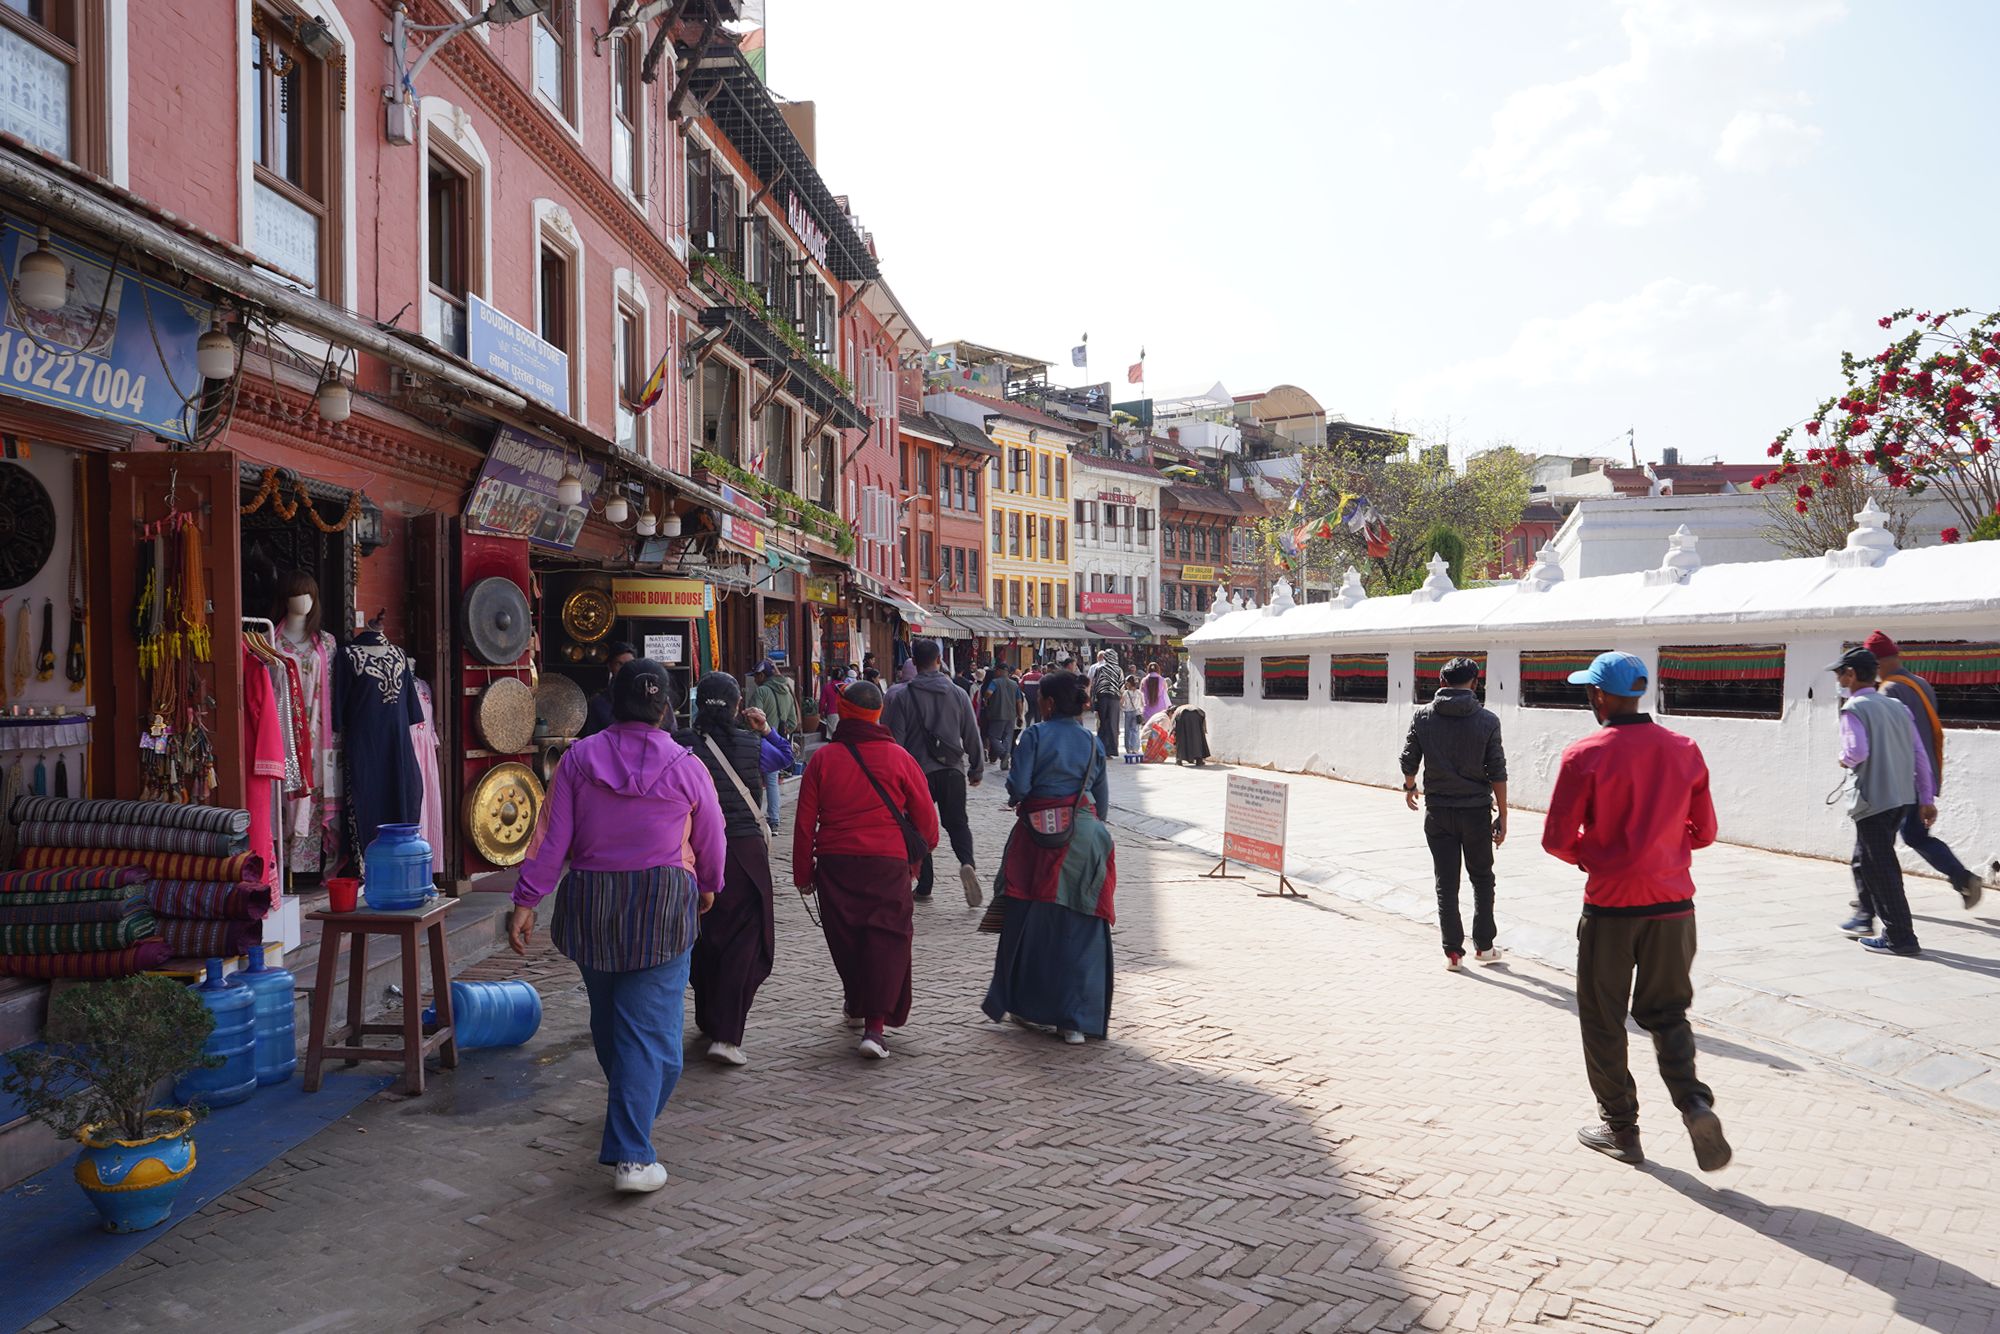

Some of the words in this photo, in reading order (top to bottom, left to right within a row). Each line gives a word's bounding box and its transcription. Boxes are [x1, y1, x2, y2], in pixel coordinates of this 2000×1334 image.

[480, 305, 514, 340] BOUDHA
[516, 328, 537, 351] BOOK
[538, 341, 561, 366] STORE
[0, 331, 147, 414] 18227004
[492, 430, 543, 475] Himalayan
[615, 591, 646, 605] SINGING
[648, 591, 673, 605] BOWL
[675, 592, 703, 605] HOUSE
